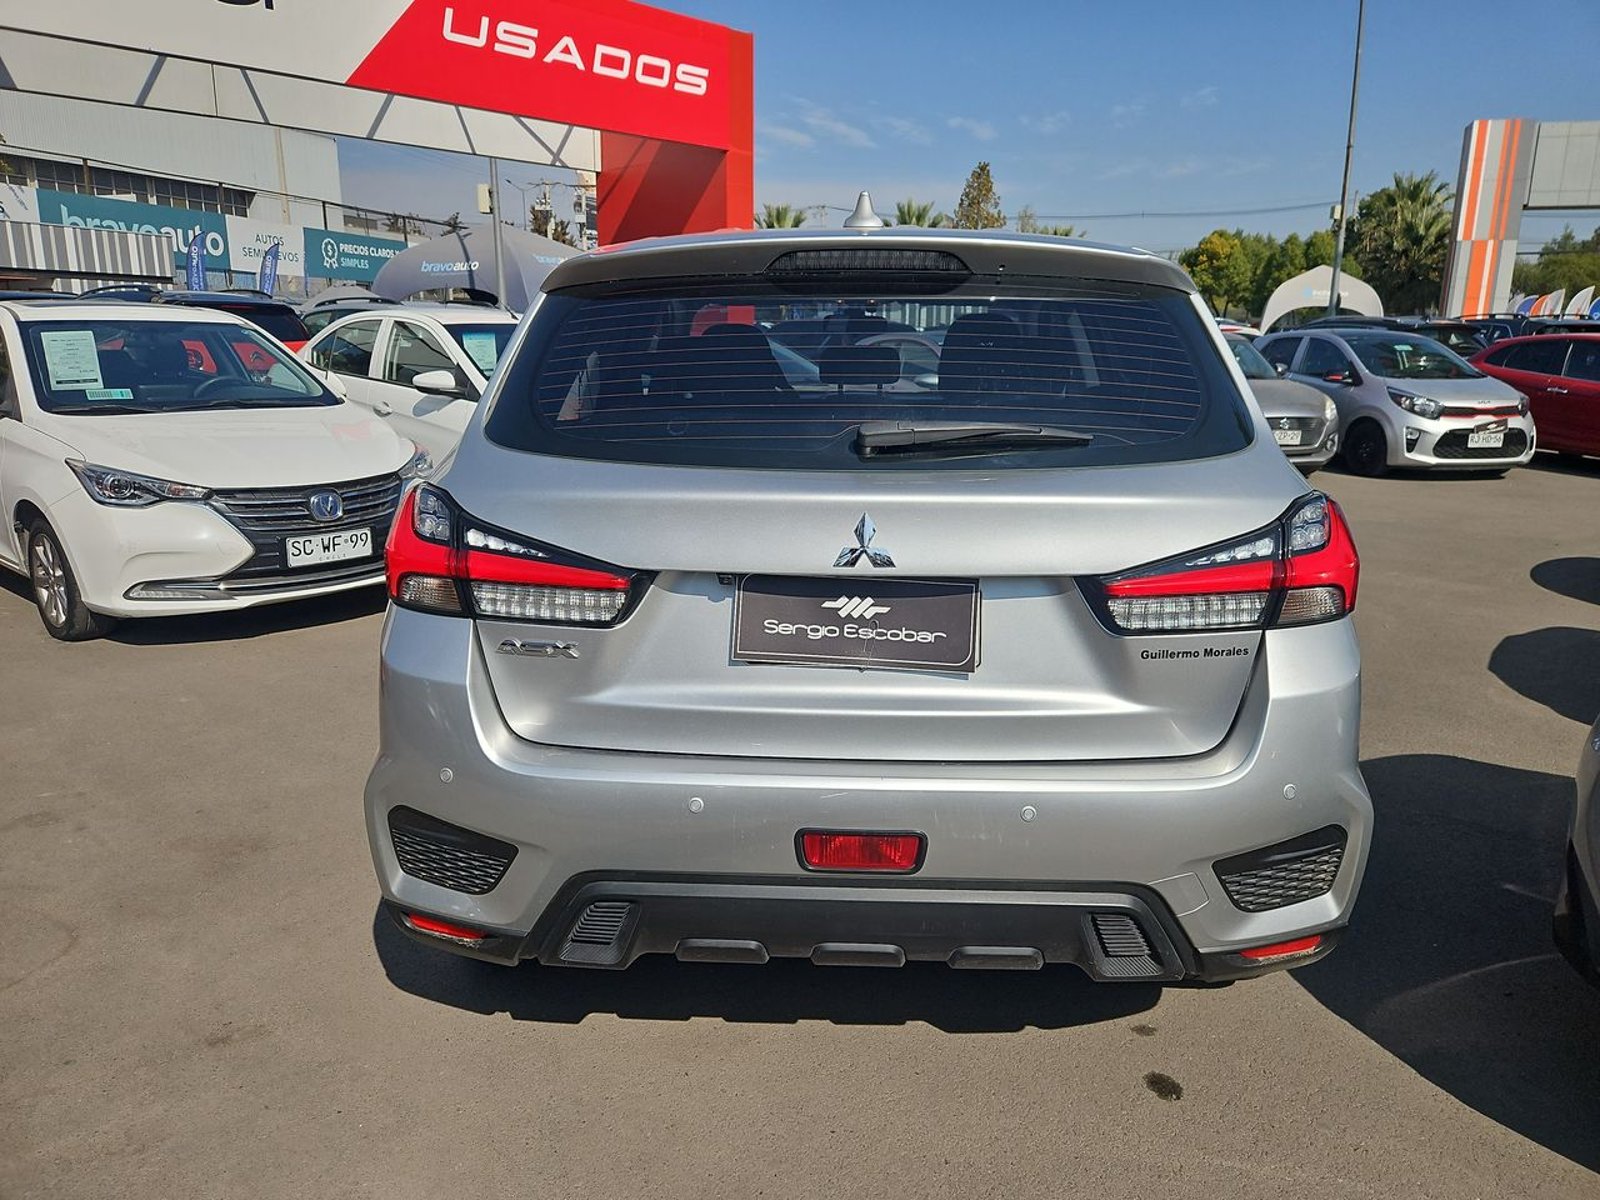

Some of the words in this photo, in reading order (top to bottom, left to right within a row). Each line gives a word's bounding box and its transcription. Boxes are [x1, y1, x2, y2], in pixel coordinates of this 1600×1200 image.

[441, 7, 709, 96] USADOS
[255, 233, 285, 246] AUTOS
[339, 243, 369, 256] PRECIOS
[369, 246, 394, 259] CLAROS
[340, 256, 369, 269] SIMPLES
[420, 260, 479, 273] bravoauto
[763, 619, 840, 639] Sergio
[843, 624, 947, 643] Escobar
[495, 637, 580, 659] ASX
[1140, 649, 1200, 660] Guillermo
[1203, 646, 1249, 658] Morales
